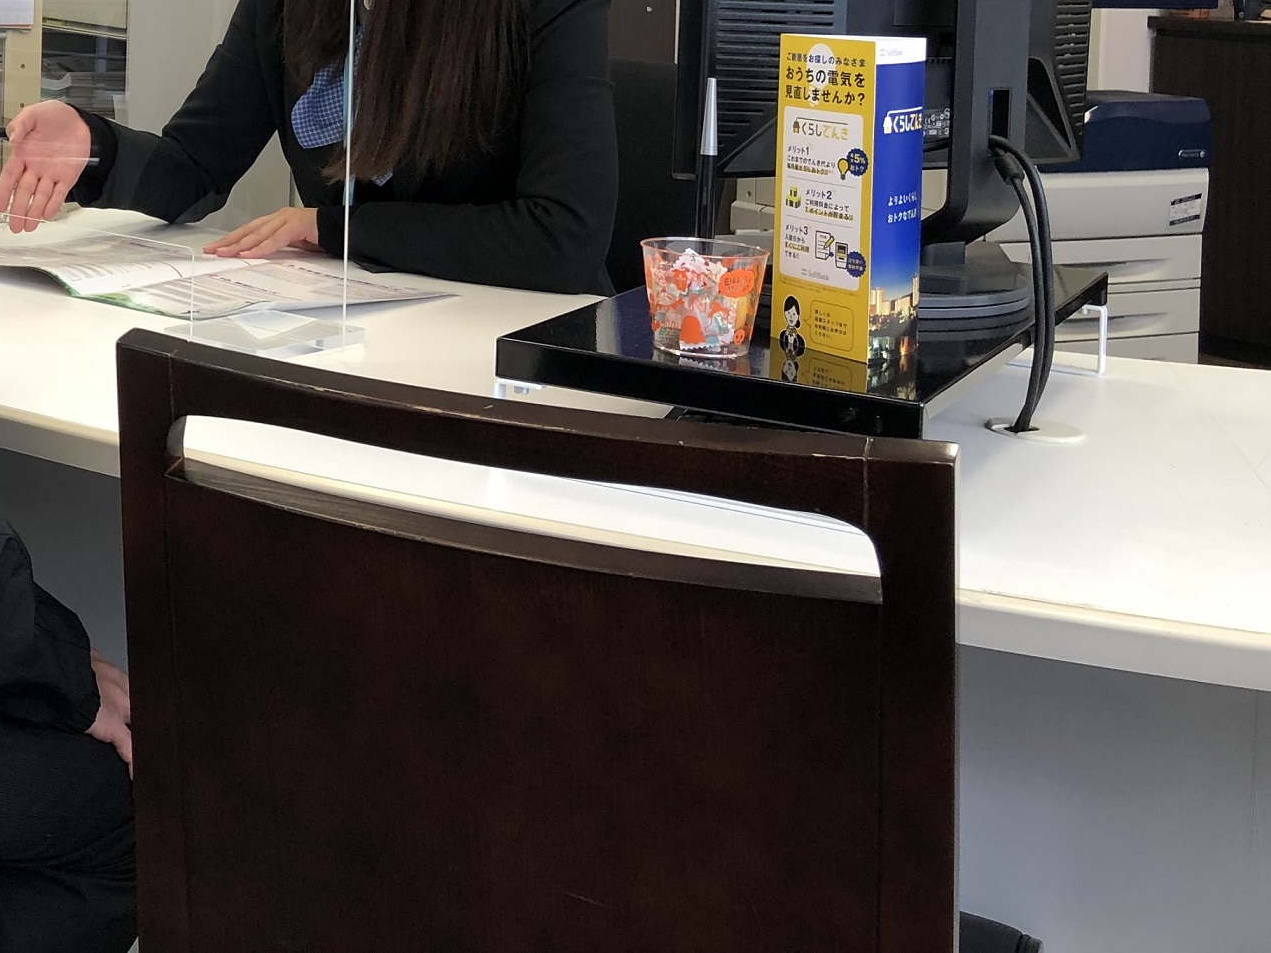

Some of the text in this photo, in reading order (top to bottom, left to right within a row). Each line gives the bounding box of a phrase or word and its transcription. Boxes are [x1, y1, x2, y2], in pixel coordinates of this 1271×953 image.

[785, 66, 866, 88] おうちの電気を
[785, 85, 866, 106] 見直しませんか?
[801, 122, 849, 141] くらしでんき
[805, 188, 832, 200] メリット2
[785, 224, 808, 235] メリット3
